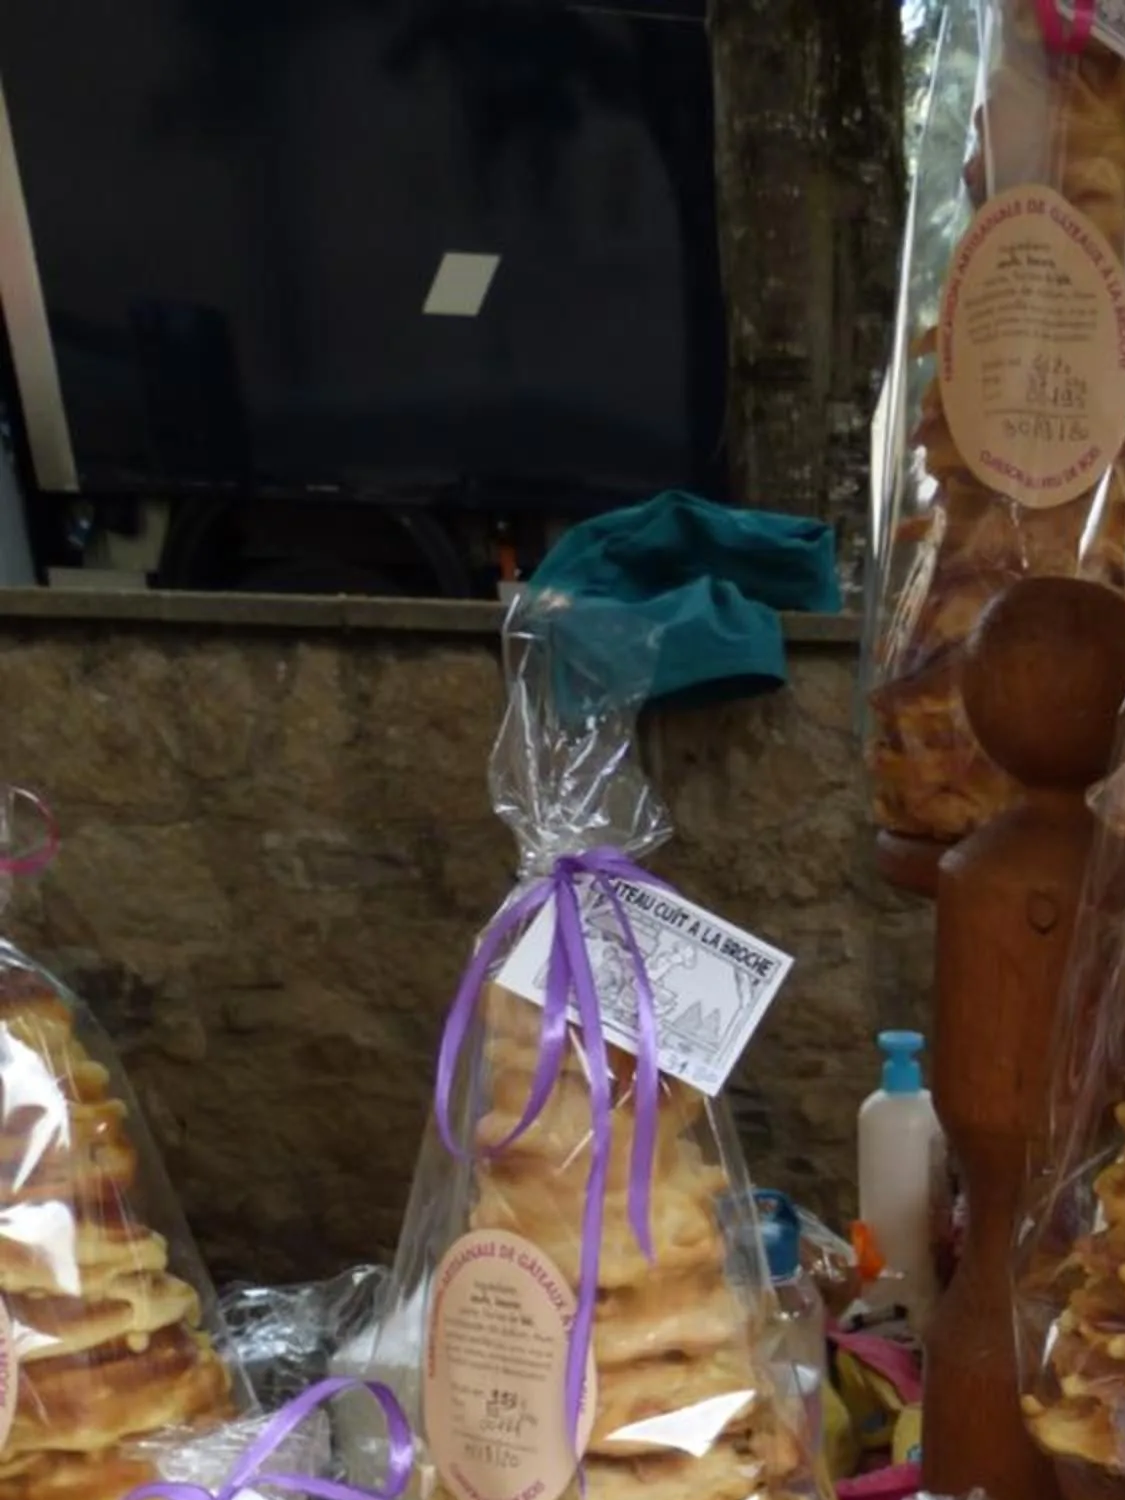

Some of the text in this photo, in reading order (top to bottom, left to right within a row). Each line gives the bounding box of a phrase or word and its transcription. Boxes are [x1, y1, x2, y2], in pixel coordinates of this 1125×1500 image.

[1028, 200, 1046, 214] DE
[688, 918, 700, 936] A
[702, 926, 722, 948] LA
[720, 938, 774, 978] BROCHE
